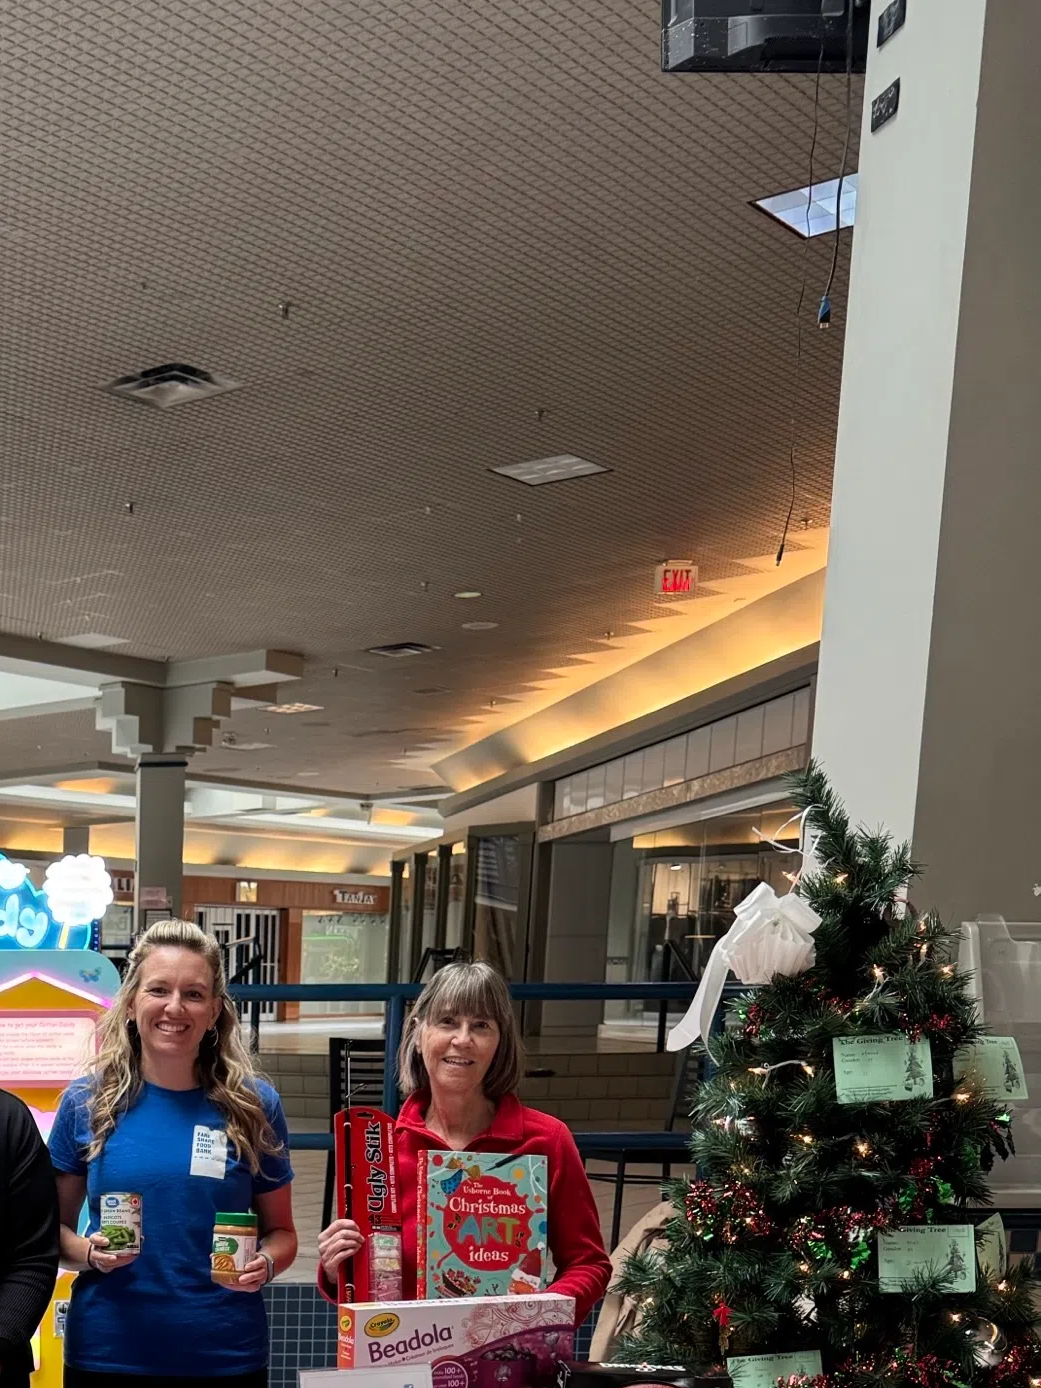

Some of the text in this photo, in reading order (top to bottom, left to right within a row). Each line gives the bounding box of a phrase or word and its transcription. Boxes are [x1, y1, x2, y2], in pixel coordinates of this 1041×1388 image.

[662, 569, 692, 592] EXIT
[856, 1036, 883, 1045] Giving
[885, 1035, 903, 1043] Tree
[364, 1120, 384, 1164] Stik
[366, 1164, 389, 1213] Ugly
[463, 1186, 512, 1197] Usborne Book
[449, 1196, 526, 1215] Christmas
[456, 1214, 521, 1247] ART
[468, 1245, 510, 1262] ideas
[367, 1322, 454, 1363] Beadola
